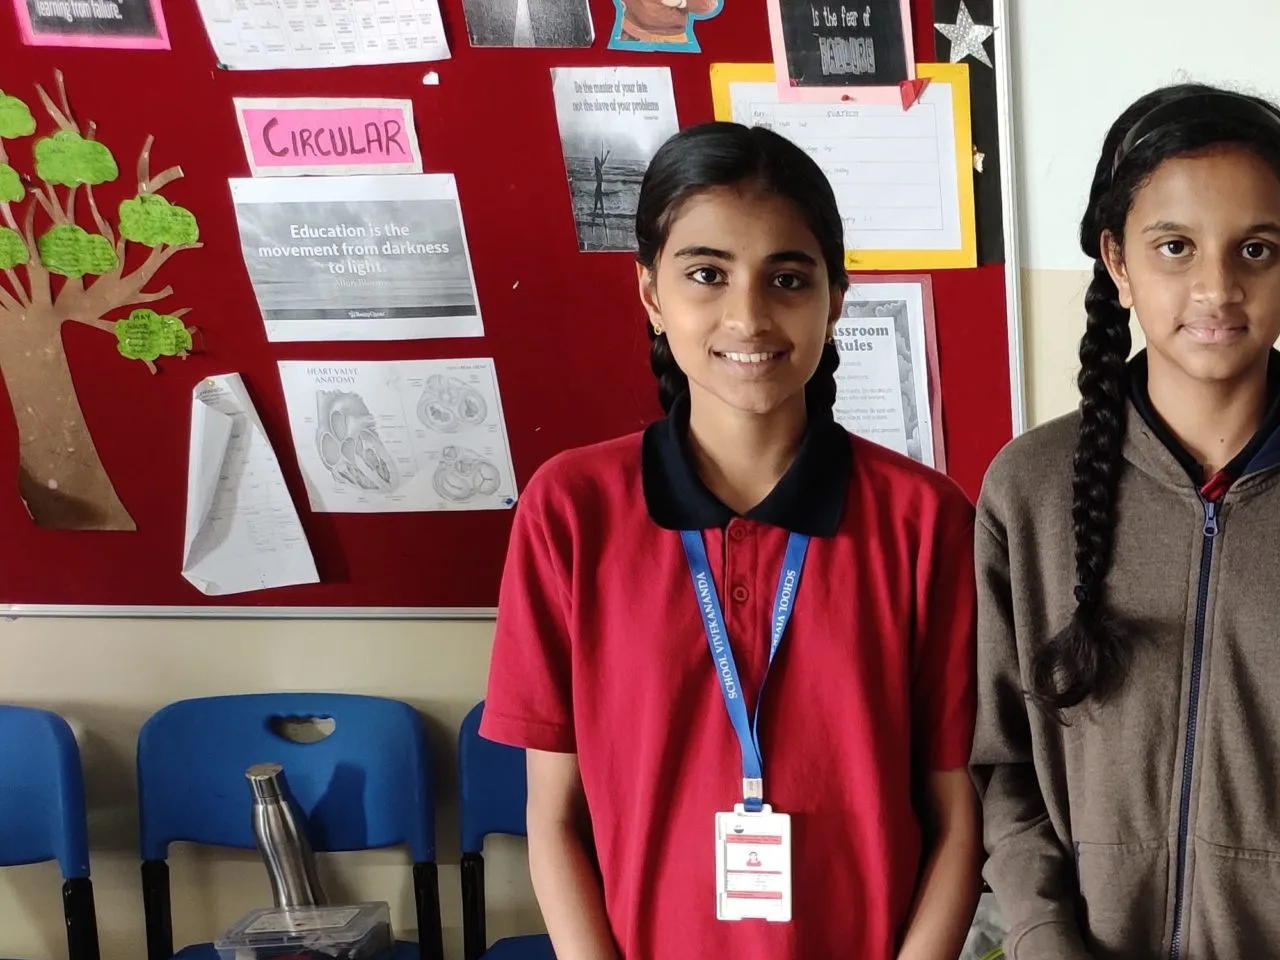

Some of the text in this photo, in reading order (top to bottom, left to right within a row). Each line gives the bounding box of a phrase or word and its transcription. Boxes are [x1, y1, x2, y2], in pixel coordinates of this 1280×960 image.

[71, 0, 92, 18] from
[823, 6, 838, 27] the
[841, 5, 859, 26] fear
[862, 5, 871, 26] of
[583, 81, 593, 93] the
[593, 82, 613, 93] master
[614, 80, 621, 93] of
[621, 84, 635, 97] your
[573, 98, 659, 115] not the slave of your problems
[263, 118, 406, 157] CIRCULAR
[290, 222, 410, 239] Education is the
[258, 241, 450, 258] movement from darkness
[328, 260, 345, 274] to
[834, 326, 889, 337] ssroom
[307, 367, 359, 376] HEART VALVE
[315, 376, 356, 384] ANATOMY
[779, 569, 796, 613] SCHOOL
[696, 572, 738, 699] SCHOOL VIVEKANANDA
